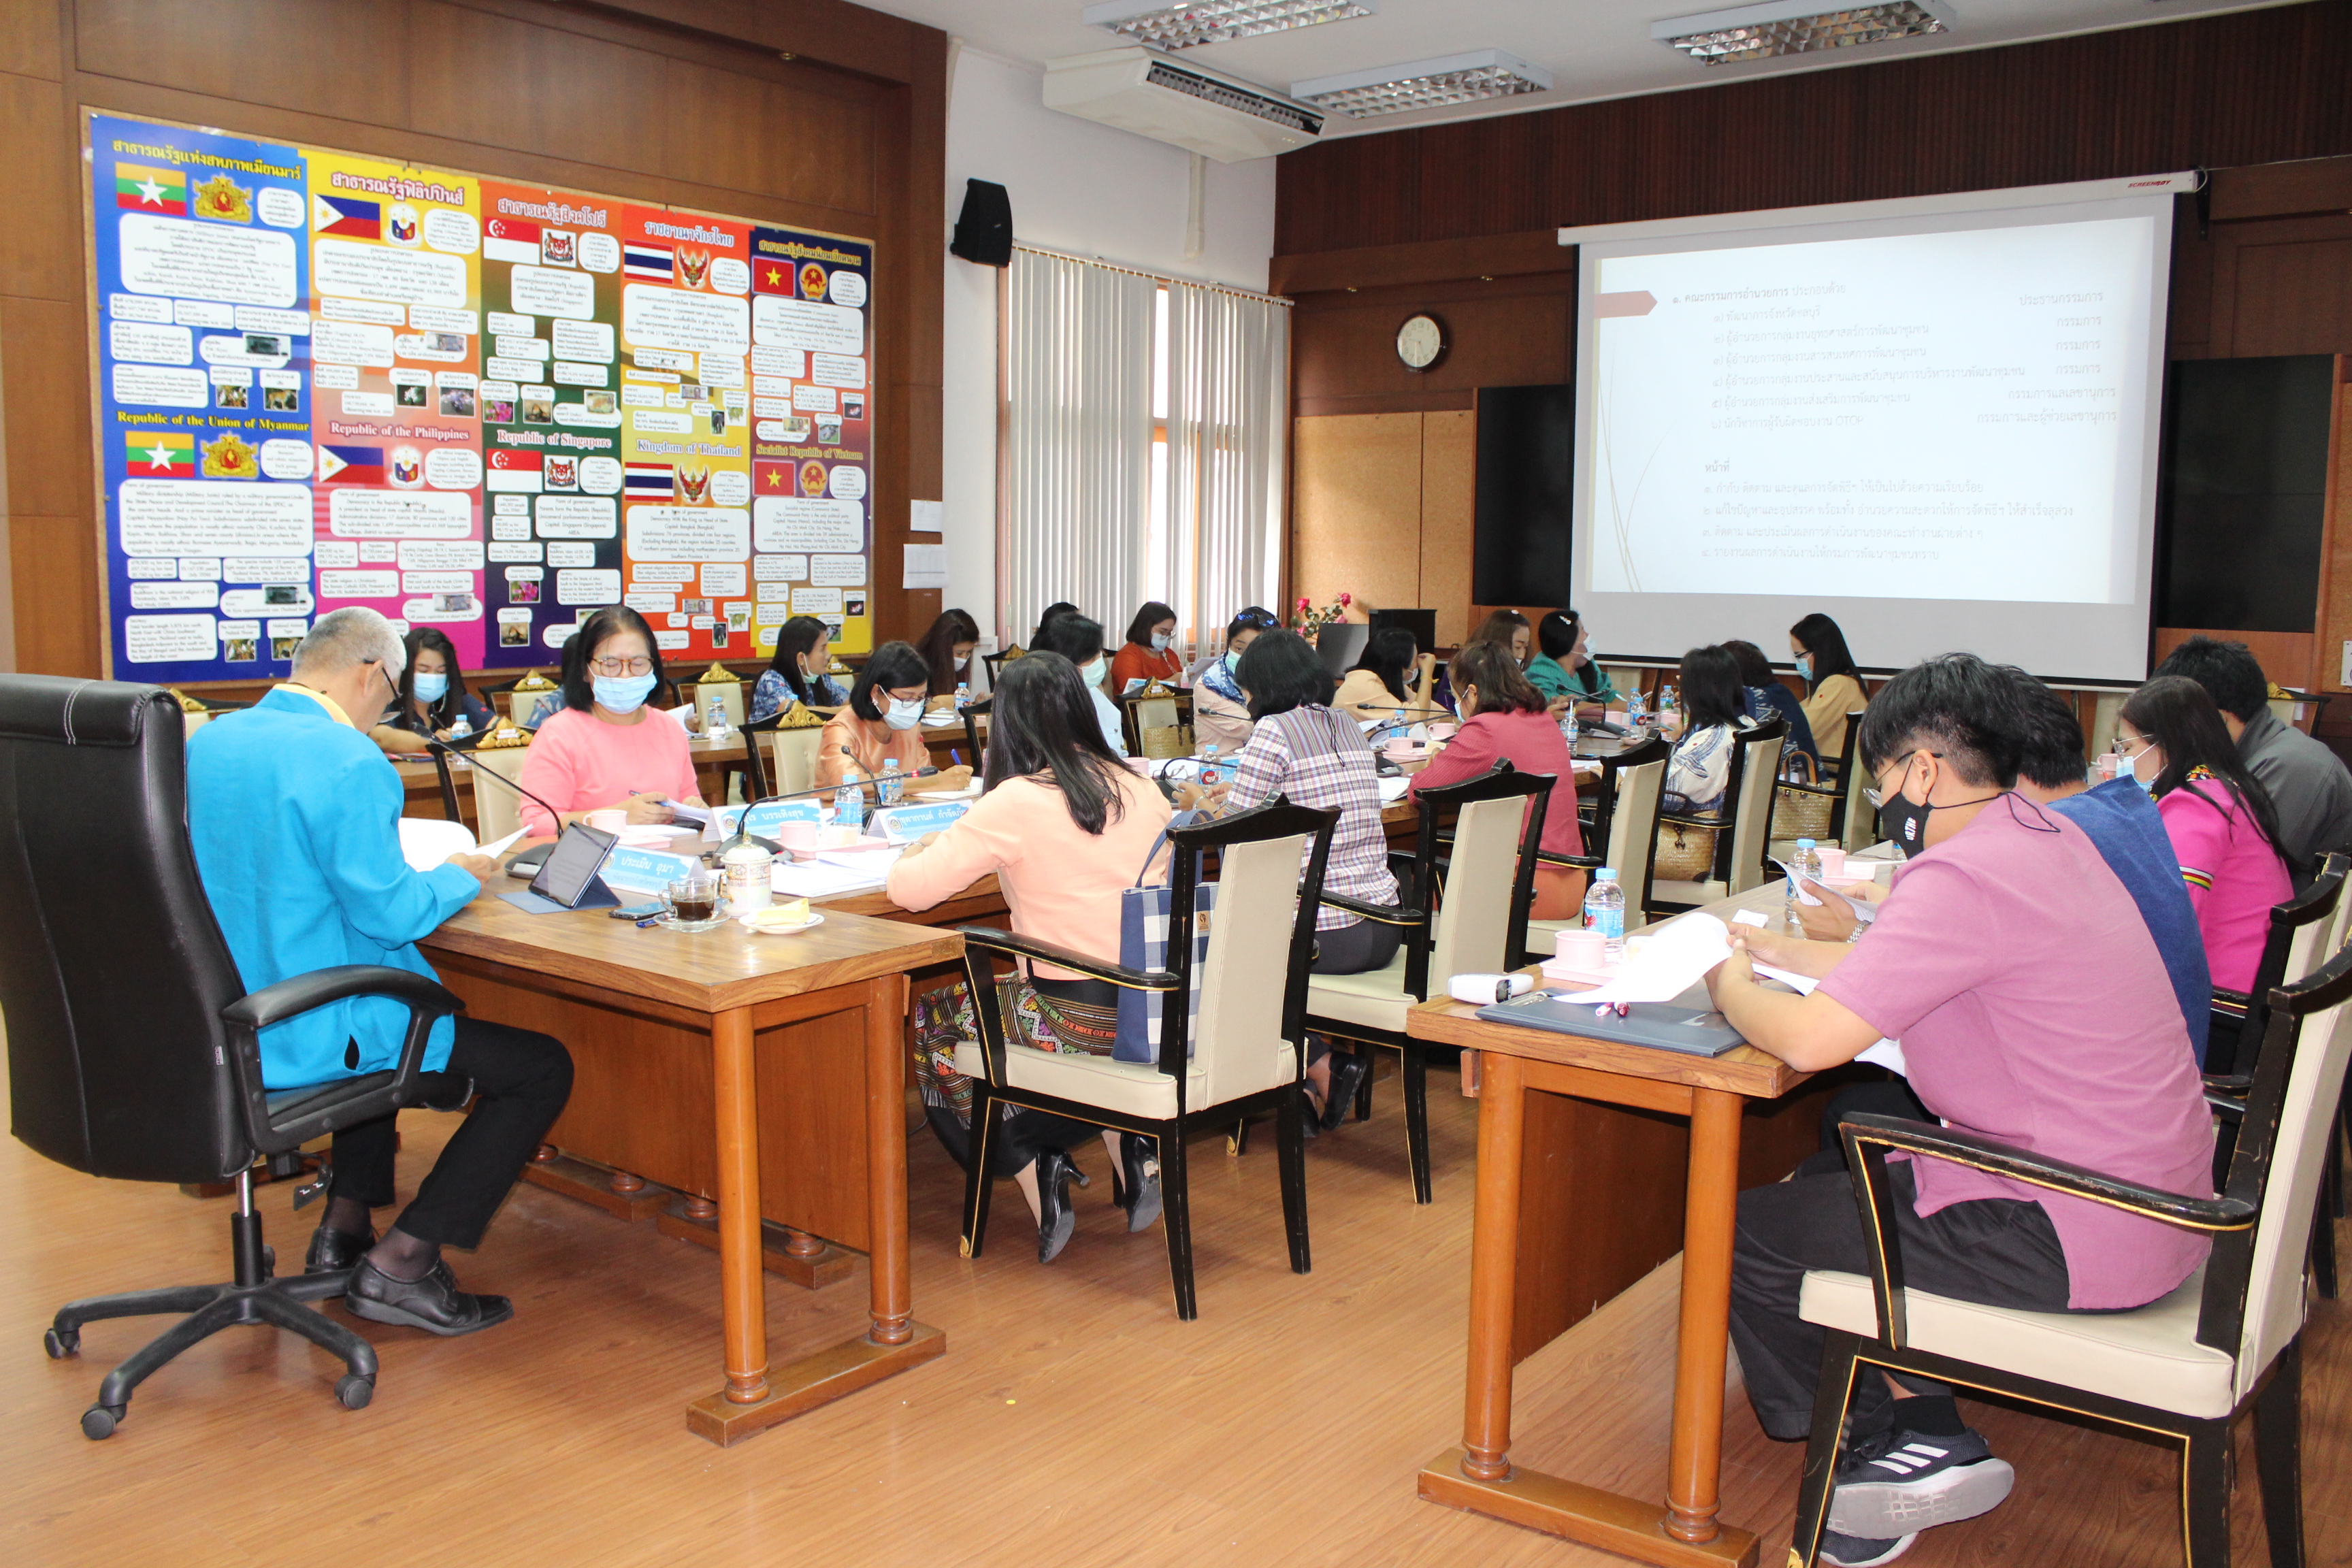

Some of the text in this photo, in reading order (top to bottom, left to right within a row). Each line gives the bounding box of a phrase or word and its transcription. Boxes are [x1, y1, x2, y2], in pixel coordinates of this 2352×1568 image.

[331, 172, 464, 206] สาธารณรัฐฟิลิปปินส์
[497, 198, 607, 227] สาธารณรัฐสิงคโปร์
[644, 220, 735, 247] ราชอาณาจักรไทย
[1684, 287, 1788, 302] คณะกรรมการอำนวยการ
[2019, 293, 2104, 306] ประธานกรรมการ
[2057, 316, 2102, 327] กรรมการ
[2057, 340, 2101, 350] กรรมการ
[2056, 364, 2101, 374] กรรมการ
[116, 411, 310, 431] Republic of the Union of Myanmar
[1835, 415, 1863, 425] OTOP
[330, 422, 470, 442] Republic of the Philippines
[497, 429, 612, 449] Republic of Singapore
[636, 439, 741, 457] Kingdom of Thailand
[756, 444, 863, 460] Socialist Republic of Vietnam
[1705, 457, 1730, 472] หน้าที่
[621, 856, 674, 875] ประเมิน อุมา
